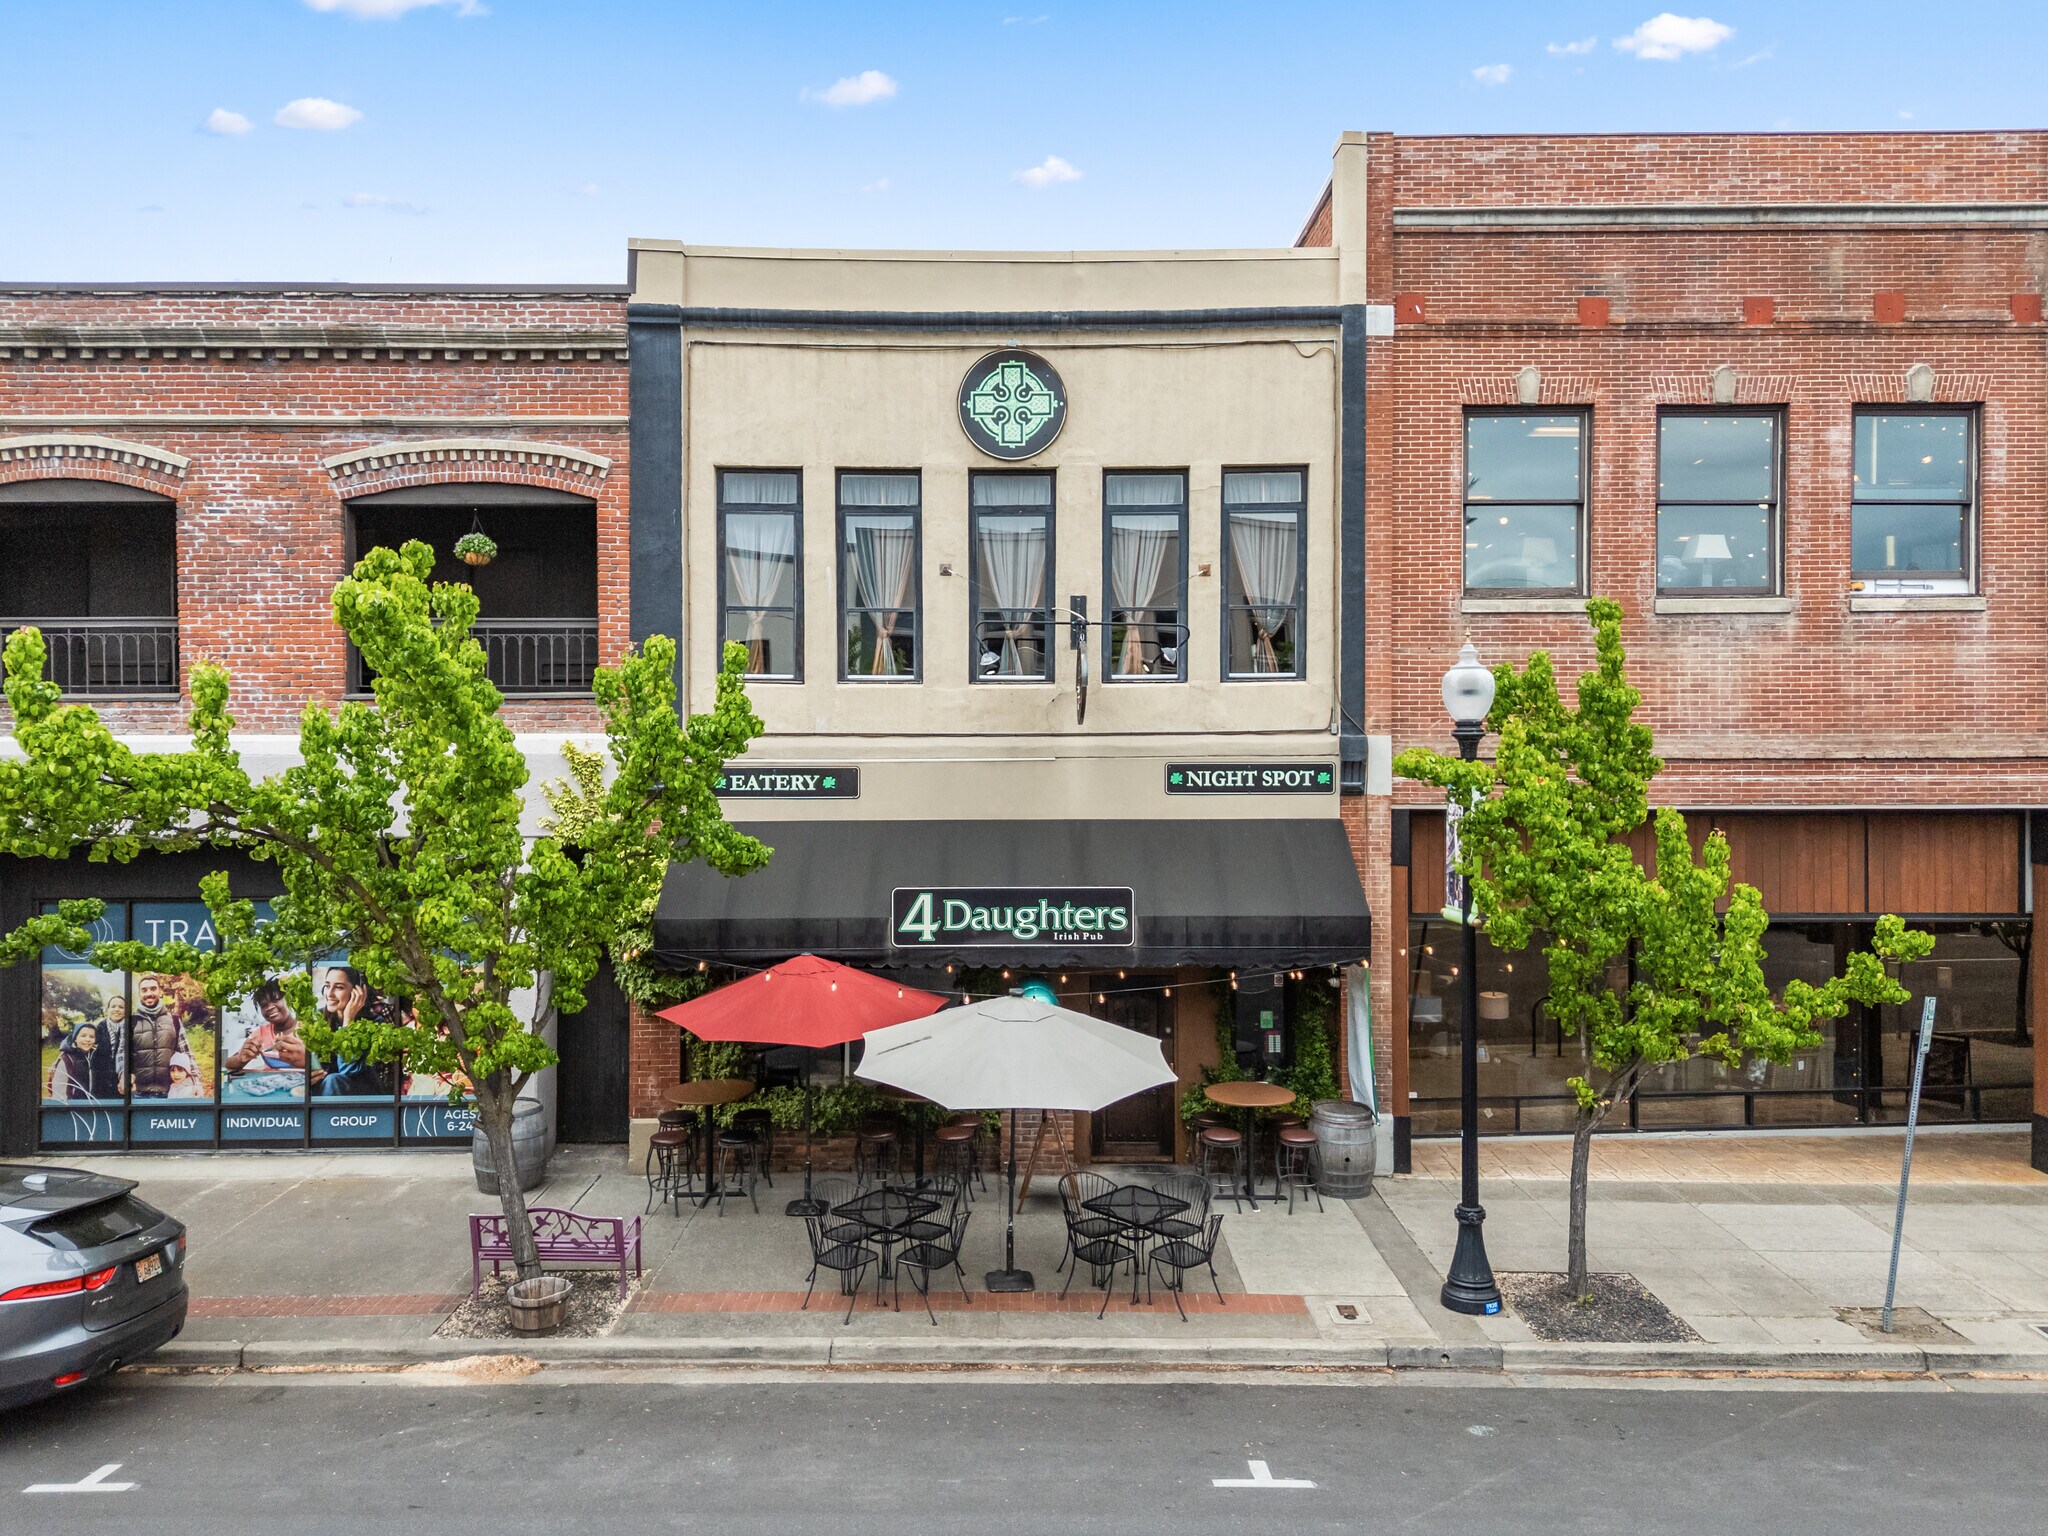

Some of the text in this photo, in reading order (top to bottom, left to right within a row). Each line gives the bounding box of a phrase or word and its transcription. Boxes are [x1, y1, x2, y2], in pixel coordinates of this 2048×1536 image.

[729, 774, 820, 791] EATERY
[1186, 769, 1315, 787] NIGHT SPOT
[898, 892, 1129, 941] 4 Daughters
[1053, 931, 1104, 941] Irish Pub
[443, 1109, 477, 1120] AGES
[150, 1118, 197, 1129] FAMILY
[226, 1117, 301, 1128] INDIVIDUAL
[330, 1115, 377, 1127] GROUP
[447, 1121, 474, 1131] 6-24
